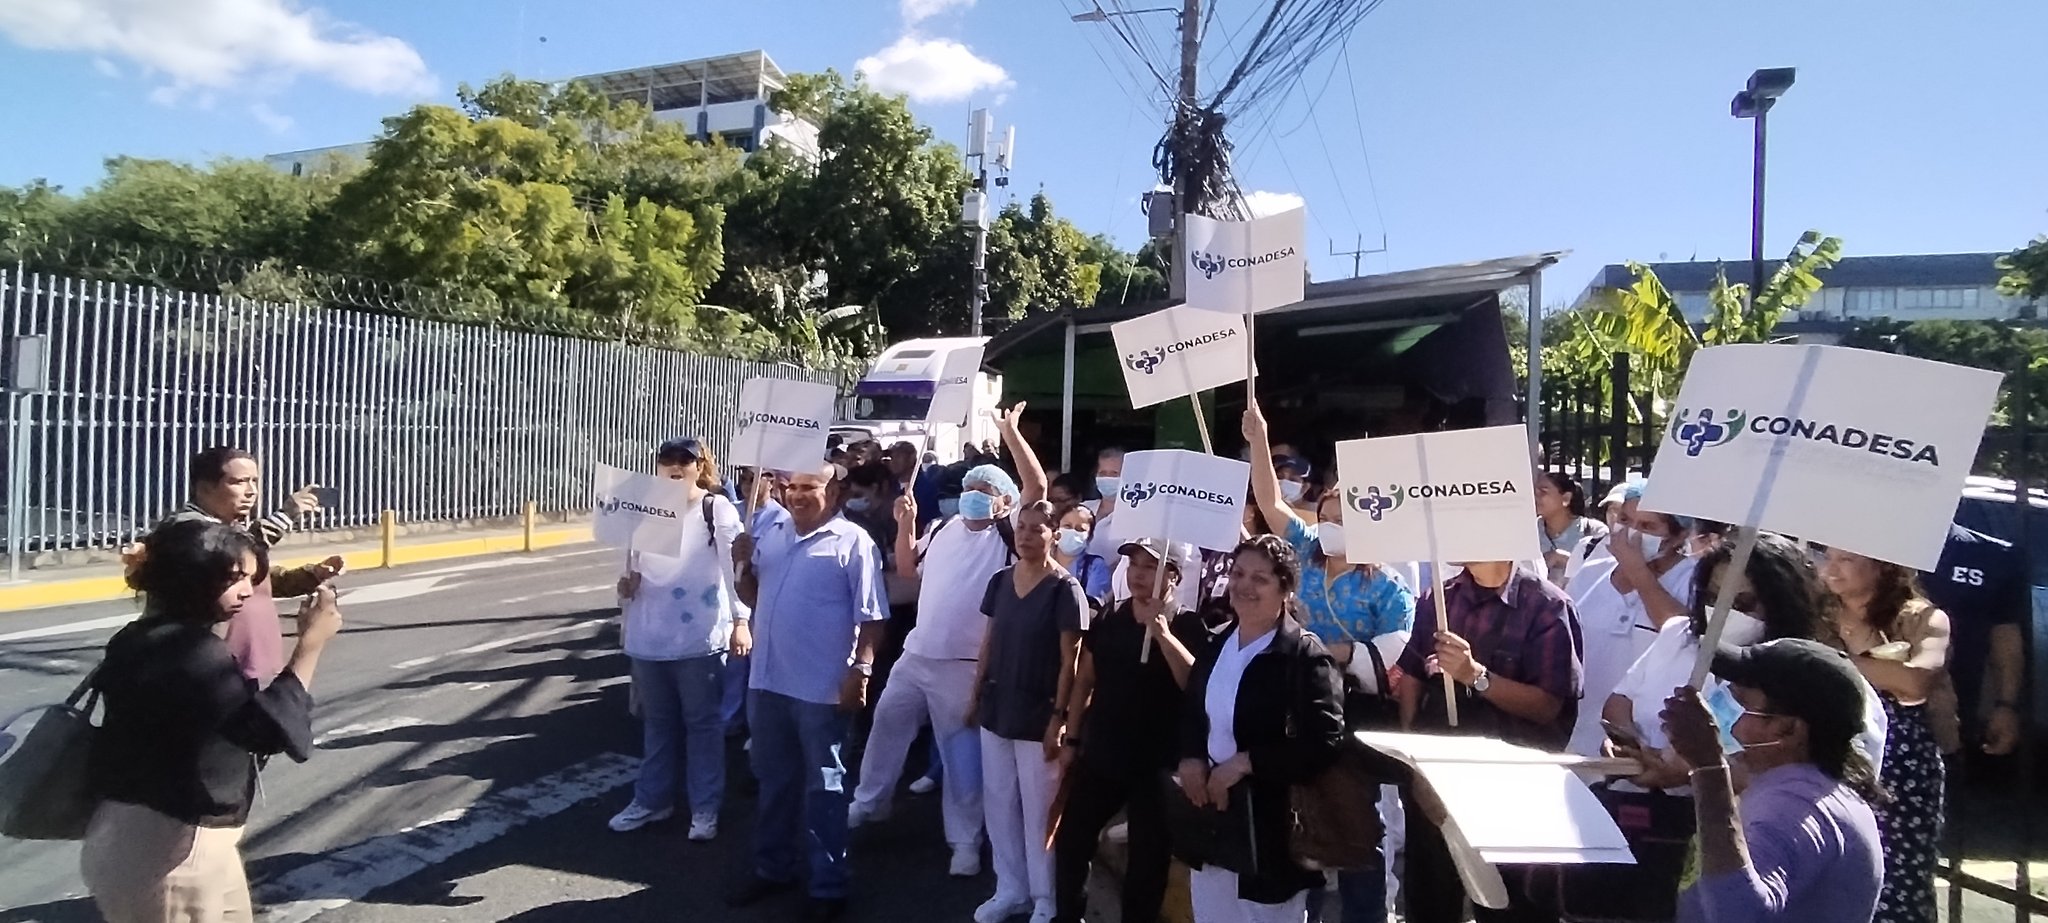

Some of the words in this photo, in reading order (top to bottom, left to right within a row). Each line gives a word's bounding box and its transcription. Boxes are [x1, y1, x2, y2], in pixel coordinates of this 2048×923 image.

[1228, 246, 1295, 268] CONADESA
[1167, 328, 1236, 353] CONADESA
[755, 413, 820, 430] CONADESA
[1749, 415, 1939, 466] CONADESA
[1159, 484, 1234, 506] CONADESA
[1408, 480, 1517, 498] CONADESA
[620, 501, 677, 518] CONADESA
[1952, 566, 1985, 586] ES
